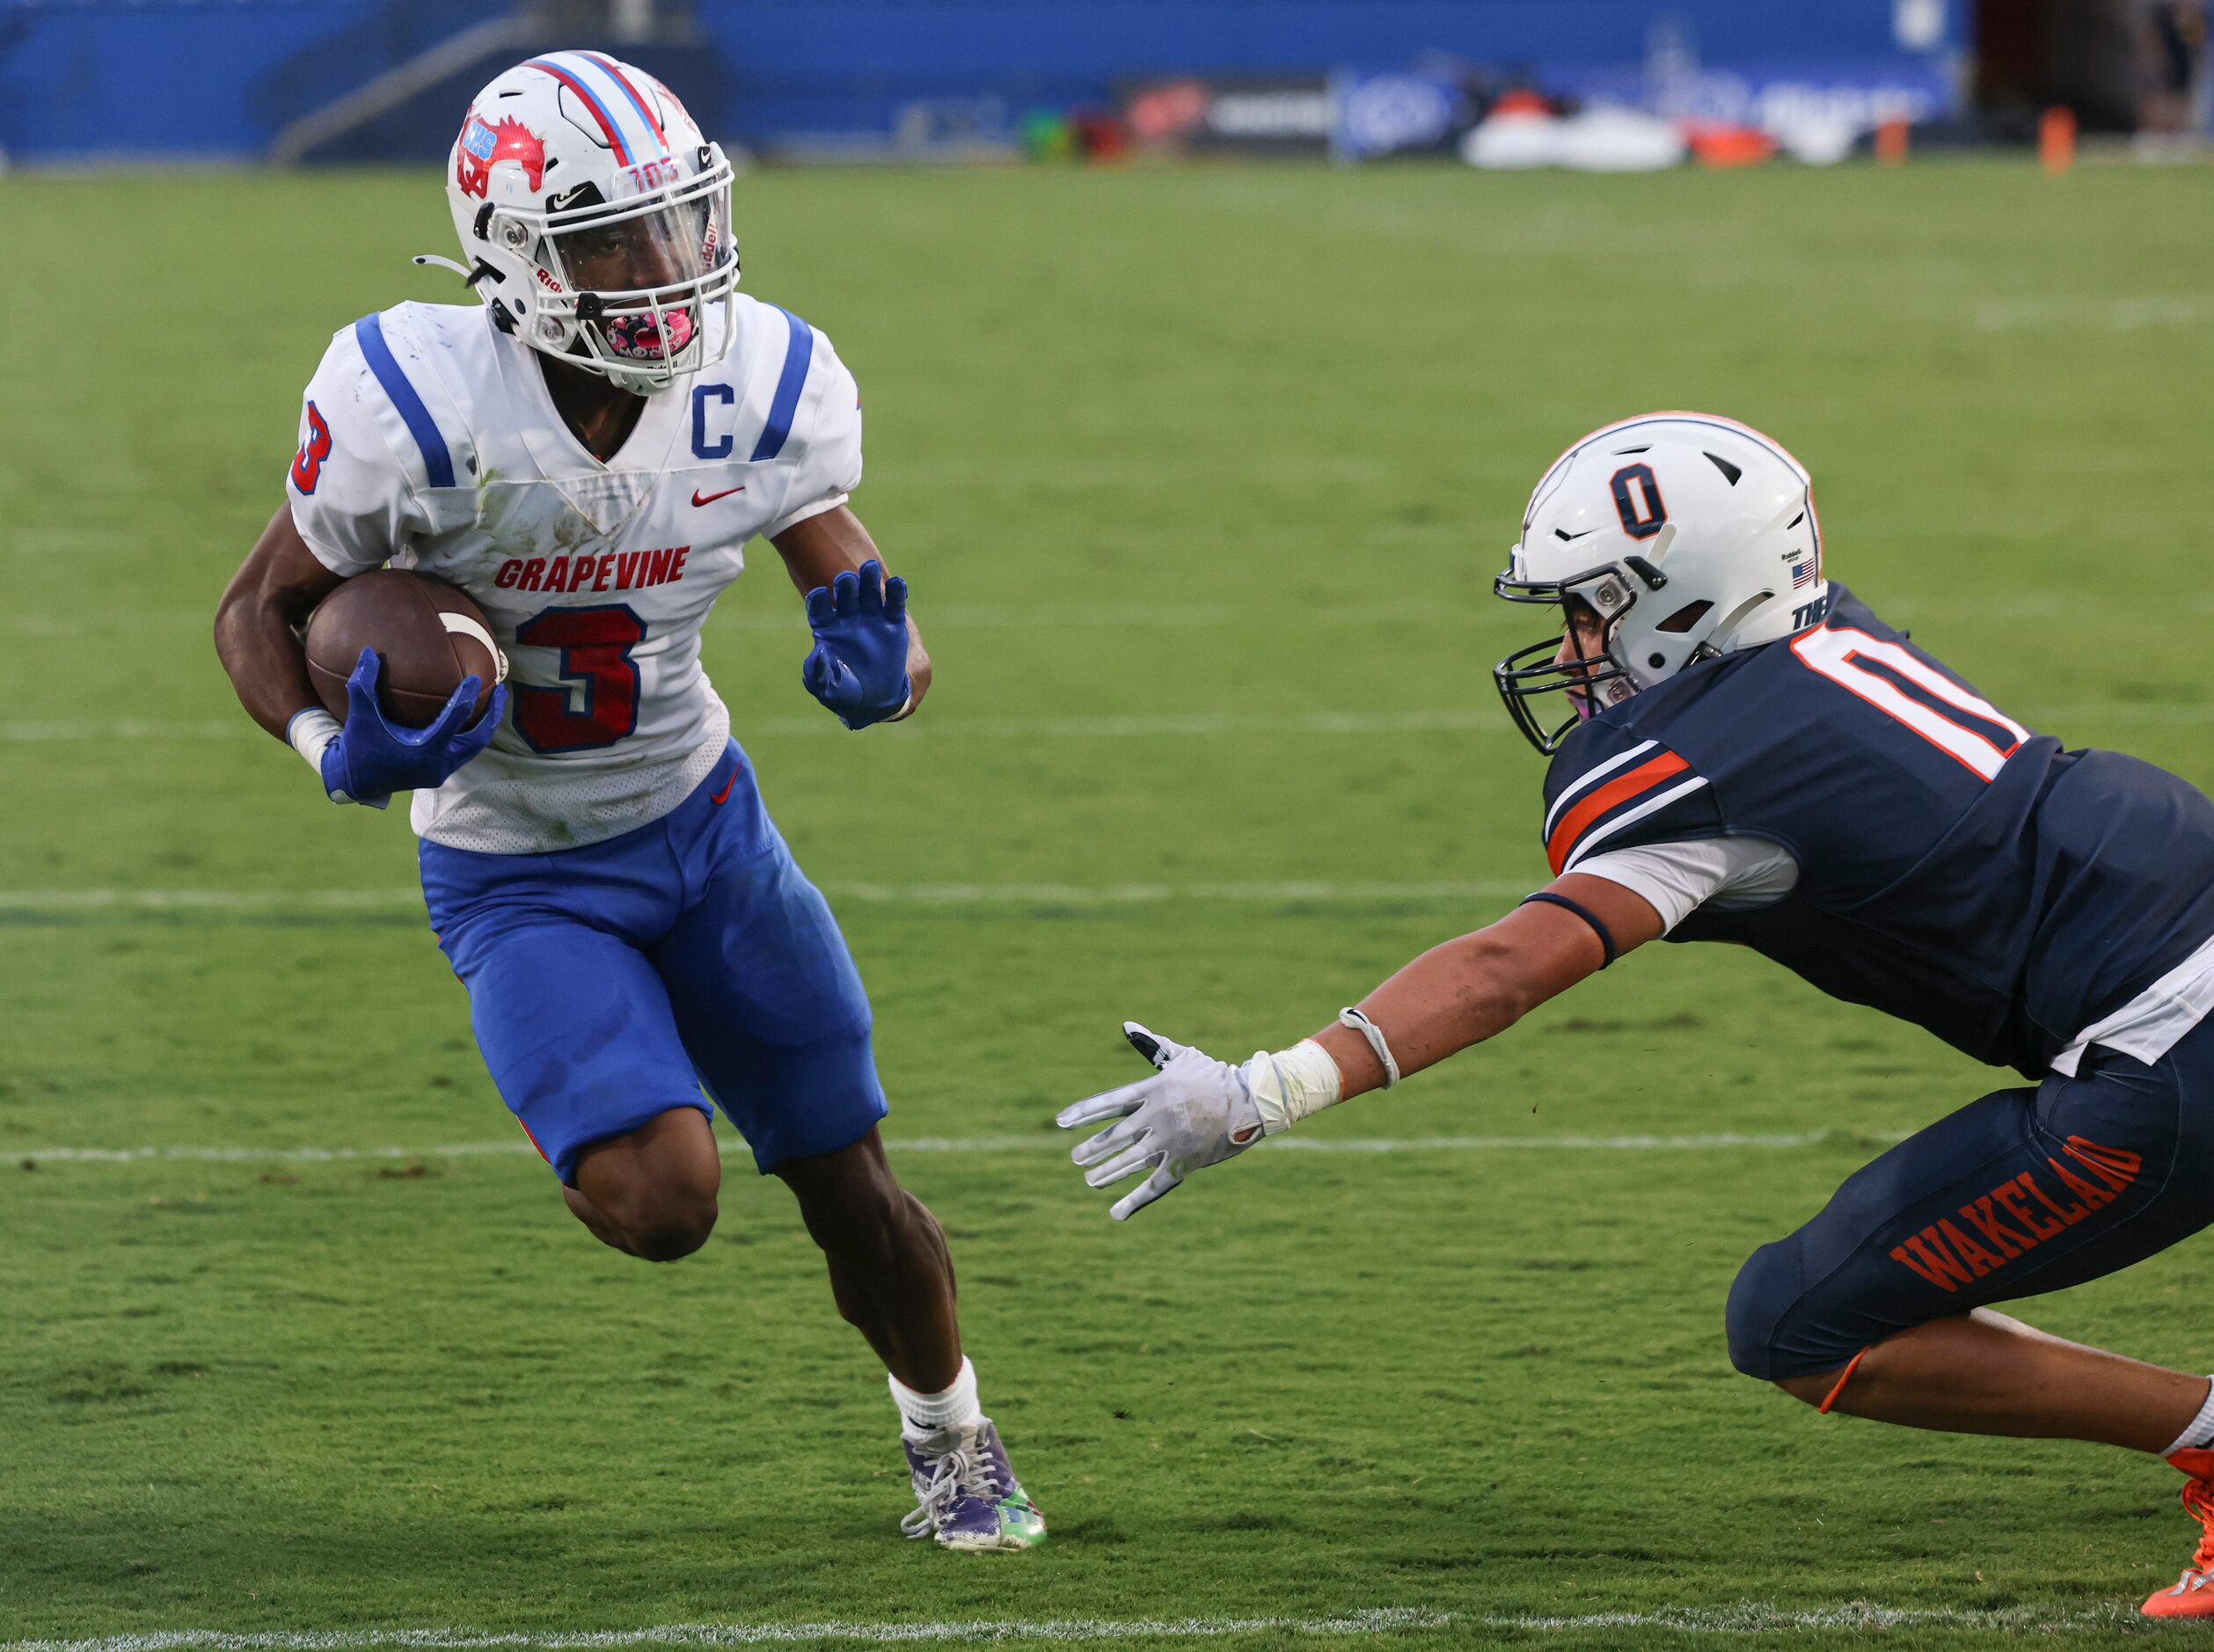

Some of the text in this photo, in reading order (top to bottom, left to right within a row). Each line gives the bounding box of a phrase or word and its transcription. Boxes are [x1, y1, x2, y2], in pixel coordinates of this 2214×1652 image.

[291, 399, 332, 495] 3
[691, 383, 734, 459] C
[493, 545, 691, 593] GRAPEVINE
[511, 603, 648, 754] 3
